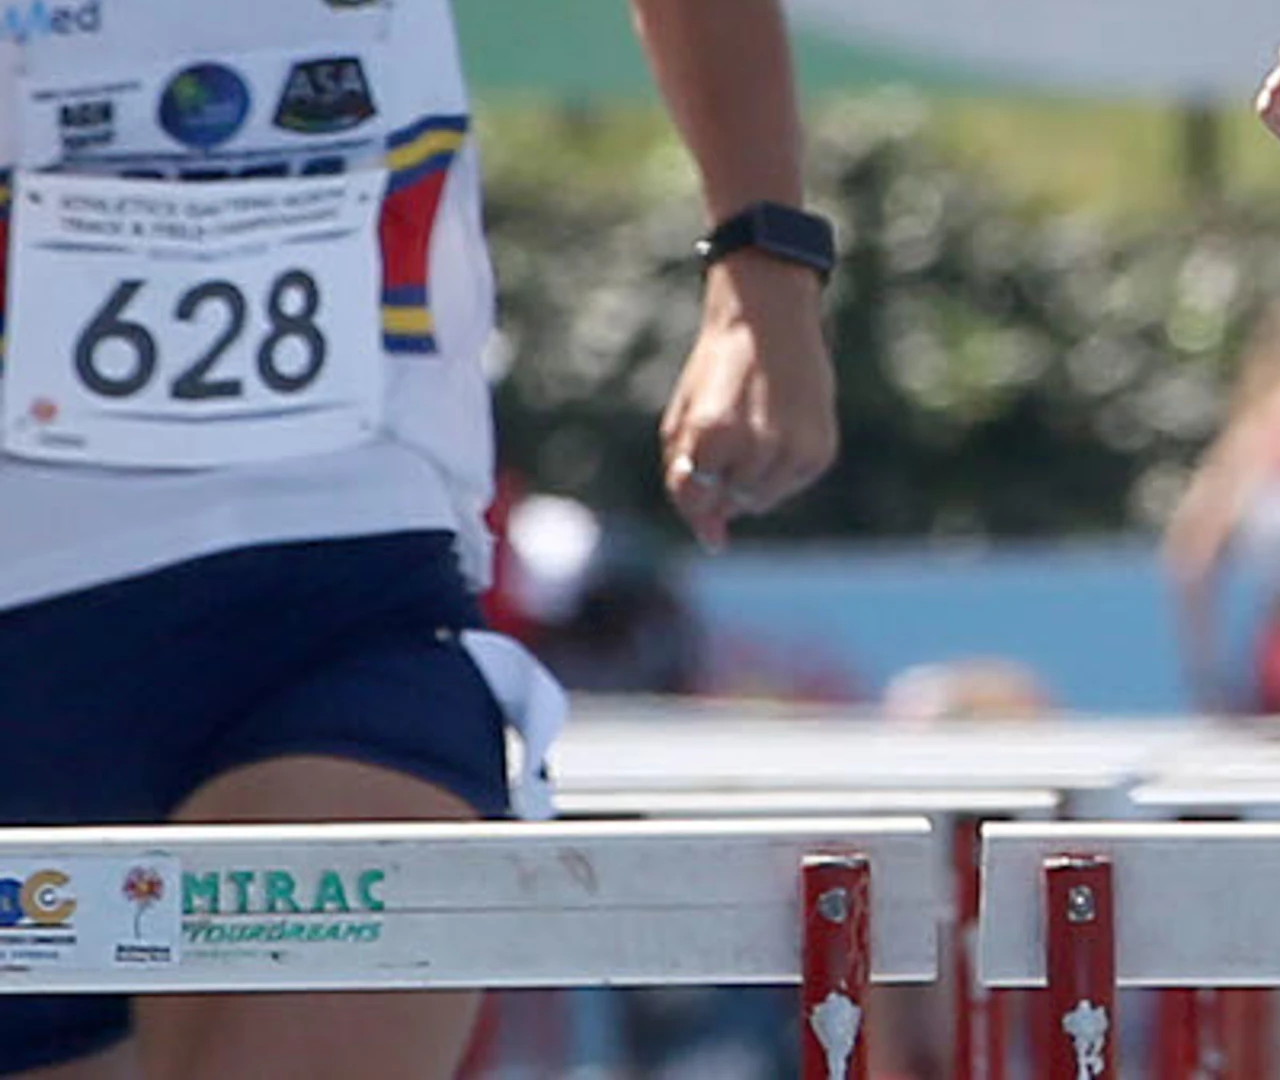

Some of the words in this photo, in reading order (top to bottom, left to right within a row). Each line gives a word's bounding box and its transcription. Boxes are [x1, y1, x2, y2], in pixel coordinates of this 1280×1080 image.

[73, 269, 328, 402] 628
[182, 868, 384, 914] MTRAC
[183, 921, 384, 943] YOURDREAMS
